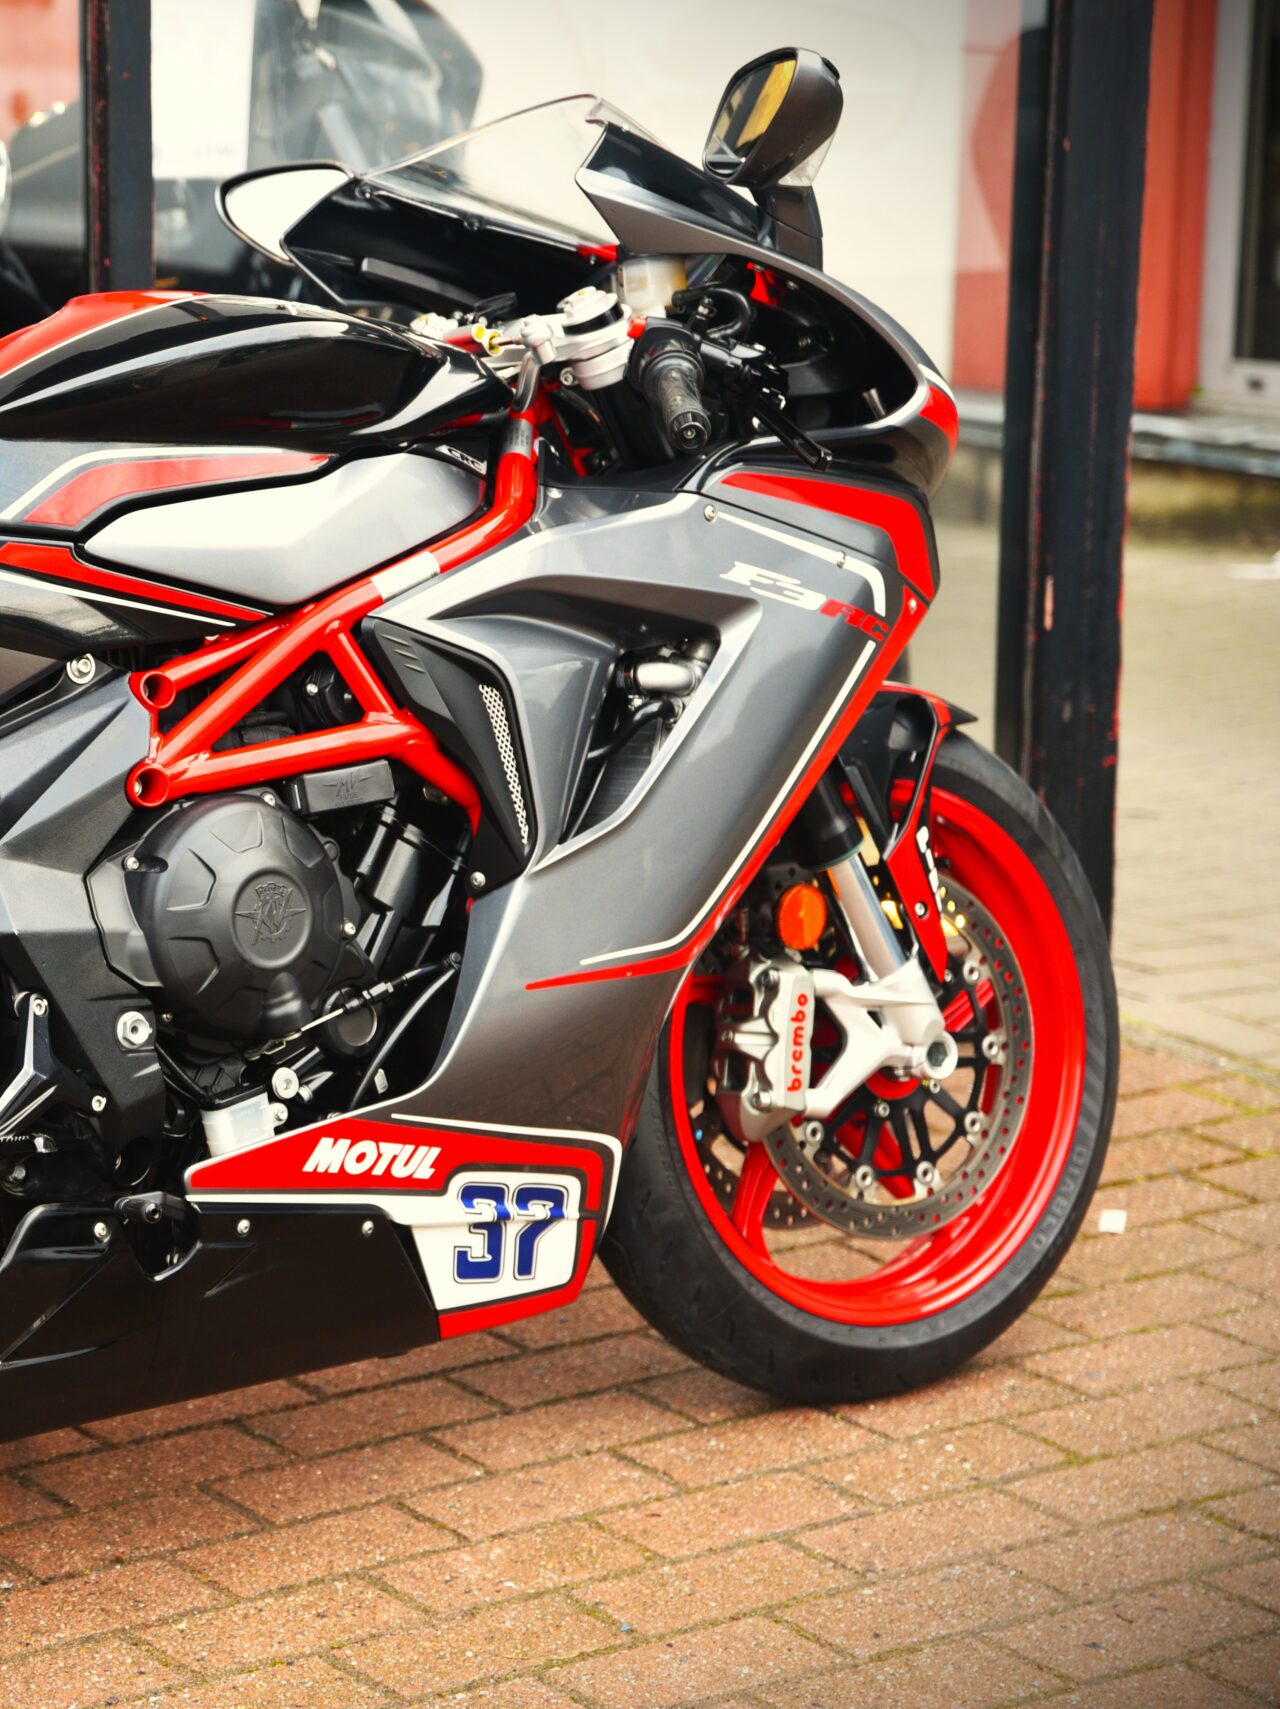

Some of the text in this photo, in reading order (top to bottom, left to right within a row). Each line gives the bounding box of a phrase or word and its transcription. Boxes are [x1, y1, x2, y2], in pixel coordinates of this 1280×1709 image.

[720, 561, 889, 642] F3 RC
[787, 993, 808, 1092] brembo
[302, 1137, 442, 1179] MOTUL
[453, 1181, 568, 1284] 37
